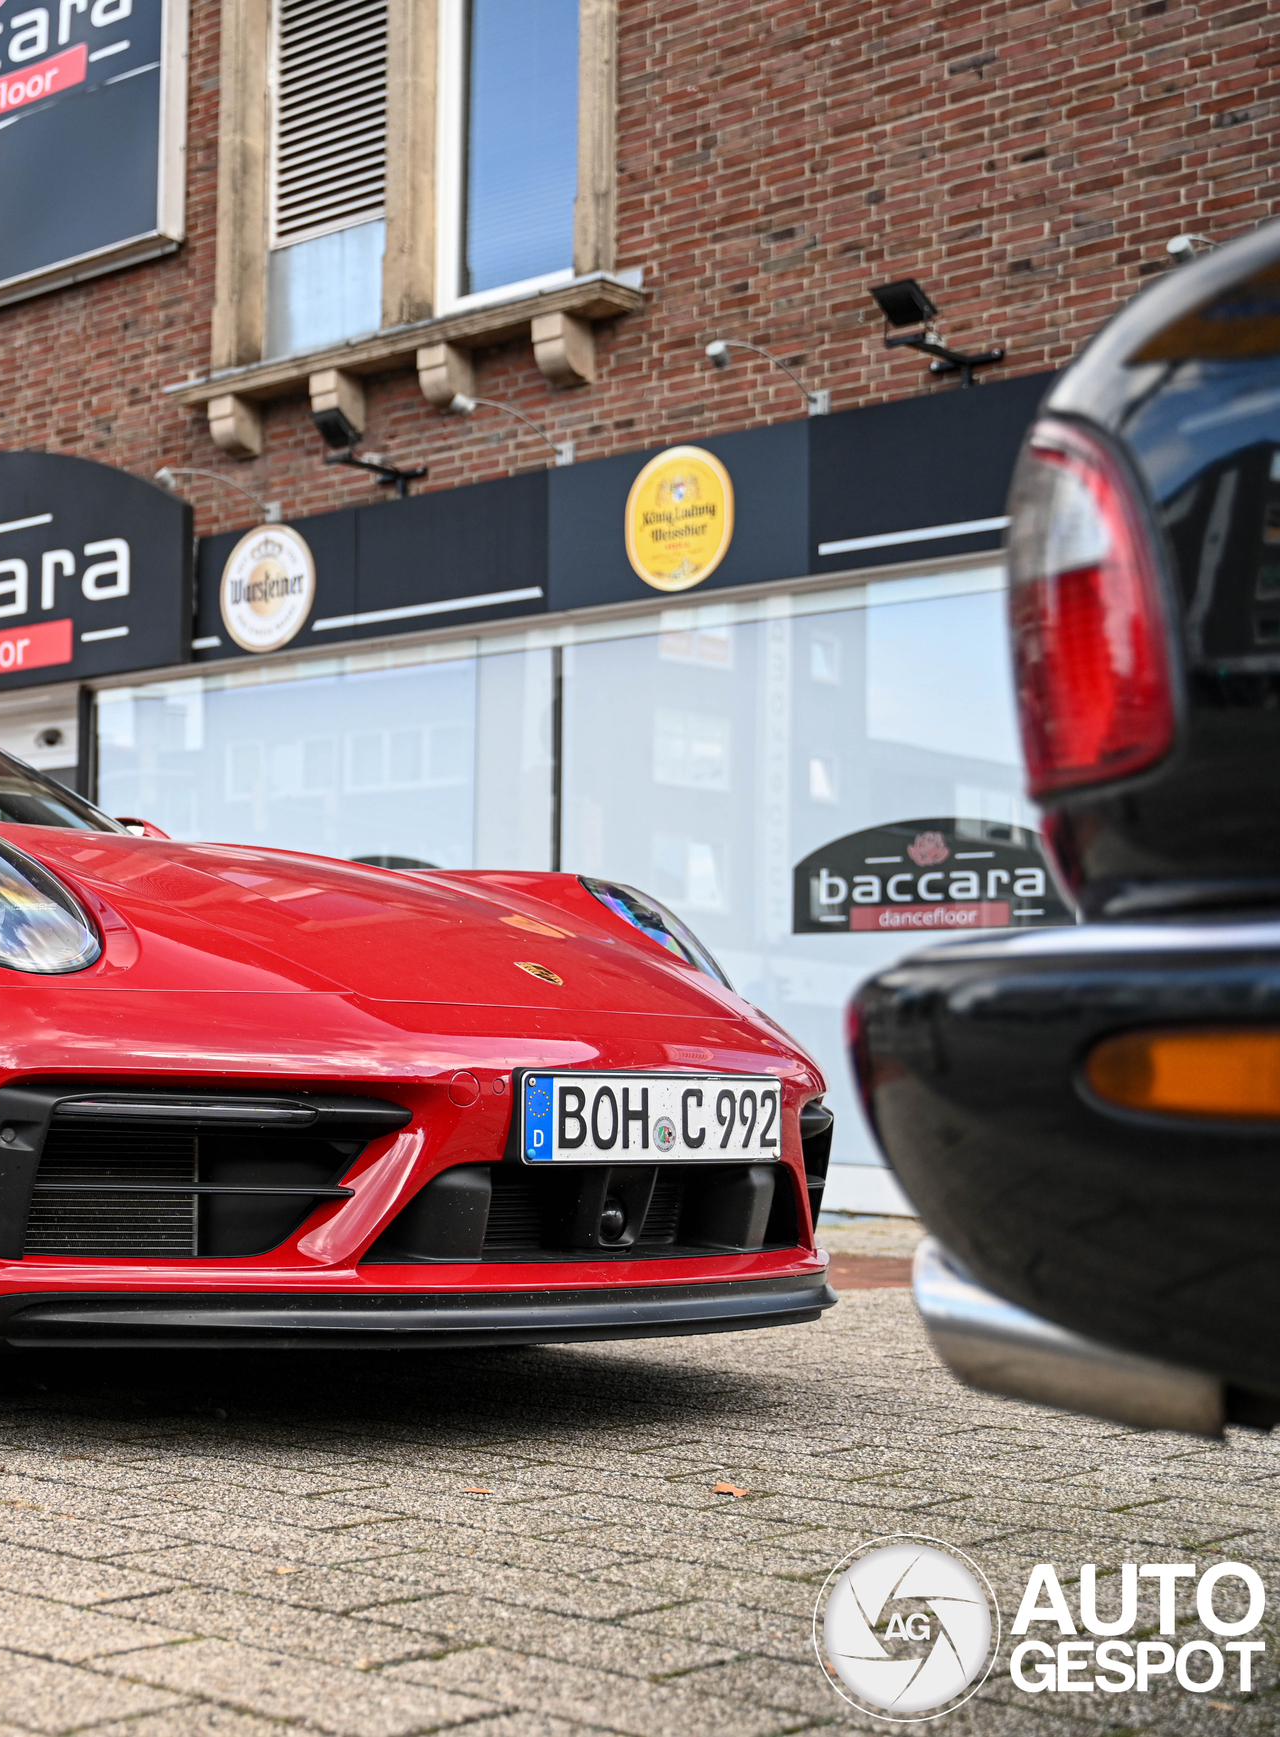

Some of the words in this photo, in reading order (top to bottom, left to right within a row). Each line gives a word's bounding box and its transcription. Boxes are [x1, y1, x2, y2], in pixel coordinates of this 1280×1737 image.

[230, 568, 304, 606] Warsteiner
[819, 867, 1046, 905] baccara
[879, 907, 979, 927] dancefloor
[533, 1129, 544, 1147] D
[558, 1086, 649, 1150] BOH
[681, 1088, 706, 1149] C
[715, 1089, 778, 1149] 992
